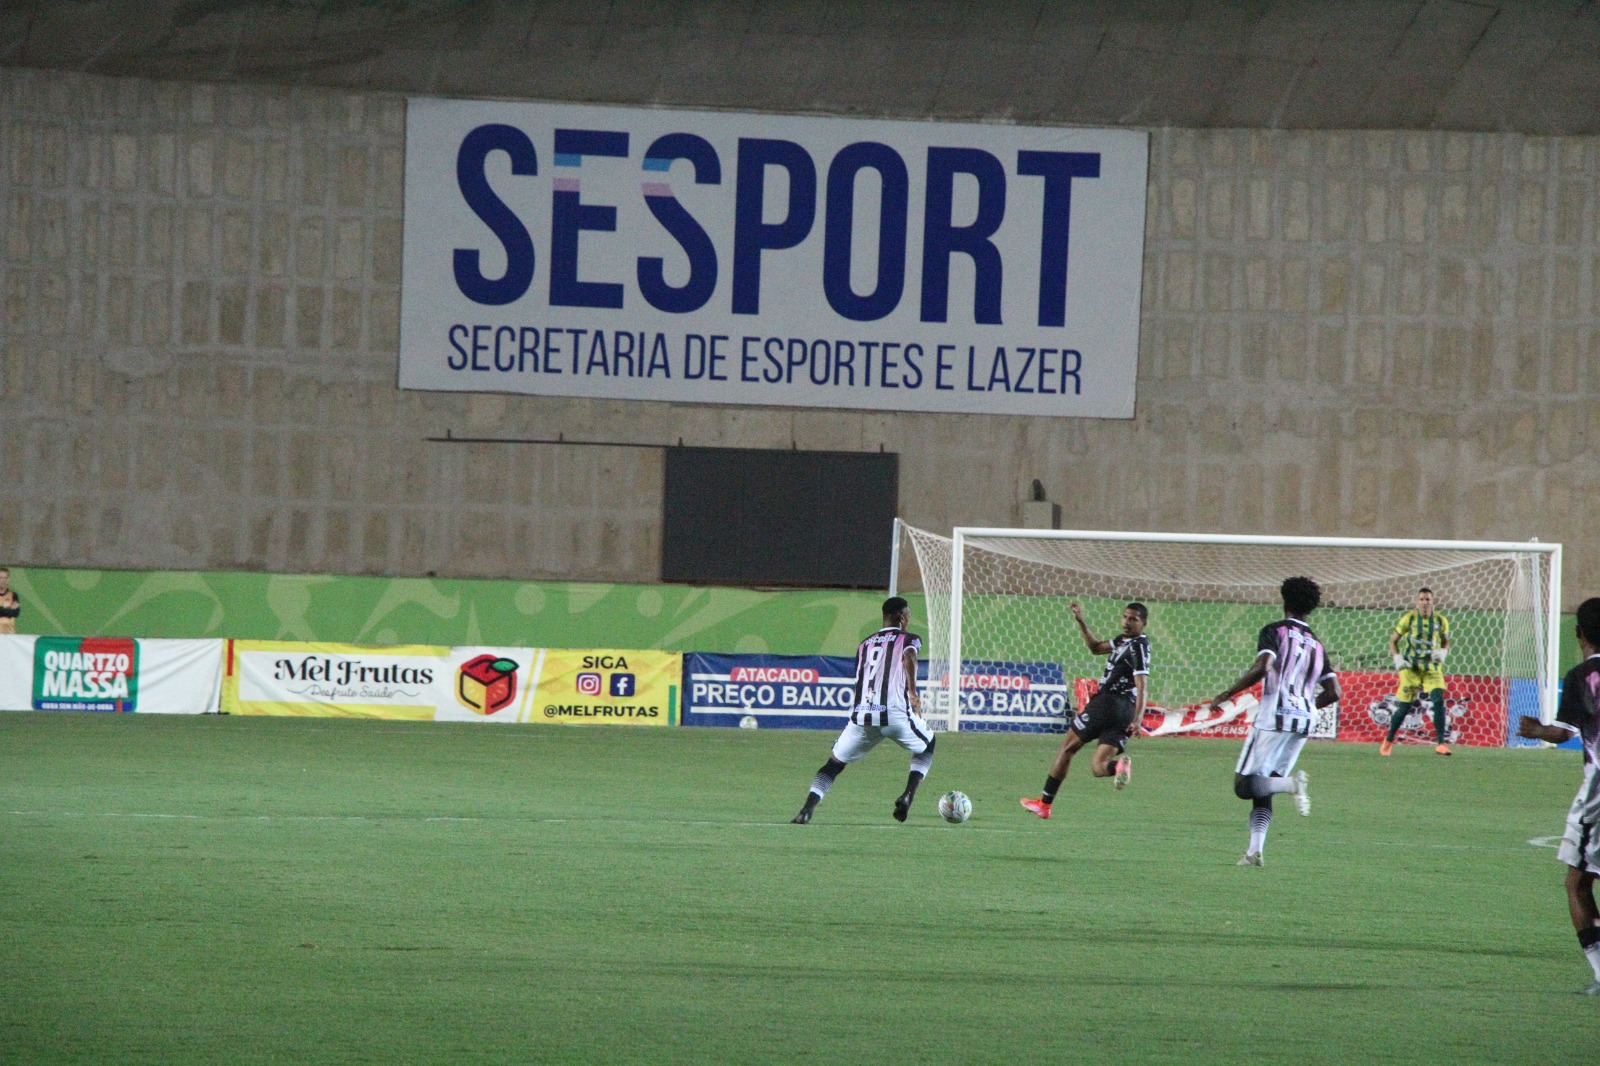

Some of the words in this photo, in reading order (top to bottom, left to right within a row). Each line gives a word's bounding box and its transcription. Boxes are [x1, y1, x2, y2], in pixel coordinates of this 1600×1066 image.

[453, 123, 1101, 328] SESPORT
[447, 324, 671, 380] SECRETARIA
[684, 334, 728, 382] DE
[741, 337, 923, 390] ESPORTES
[936, 345, 955, 390] E
[966, 346, 1083, 395] LAZER
[44, 650, 130, 672] QUARTZO
[274, 655, 331, 682] Mel
[337, 660, 434, 685] Frutas
[582, 655, 629, 670] SIGA
[869, 646, 884, 681] 9
[42, 669, 129, 698] MASSA
[736, 667, 813, 683] ATACADO
[957, 674, 1024, 690] TACADO
[692, 683, 775, 710] PREÇO
[782, 685, 856, 708] BAIXO
[992, 692, 1066, 715] BAIXO
[543, 704, 659, 718] @MELFRUTAS
